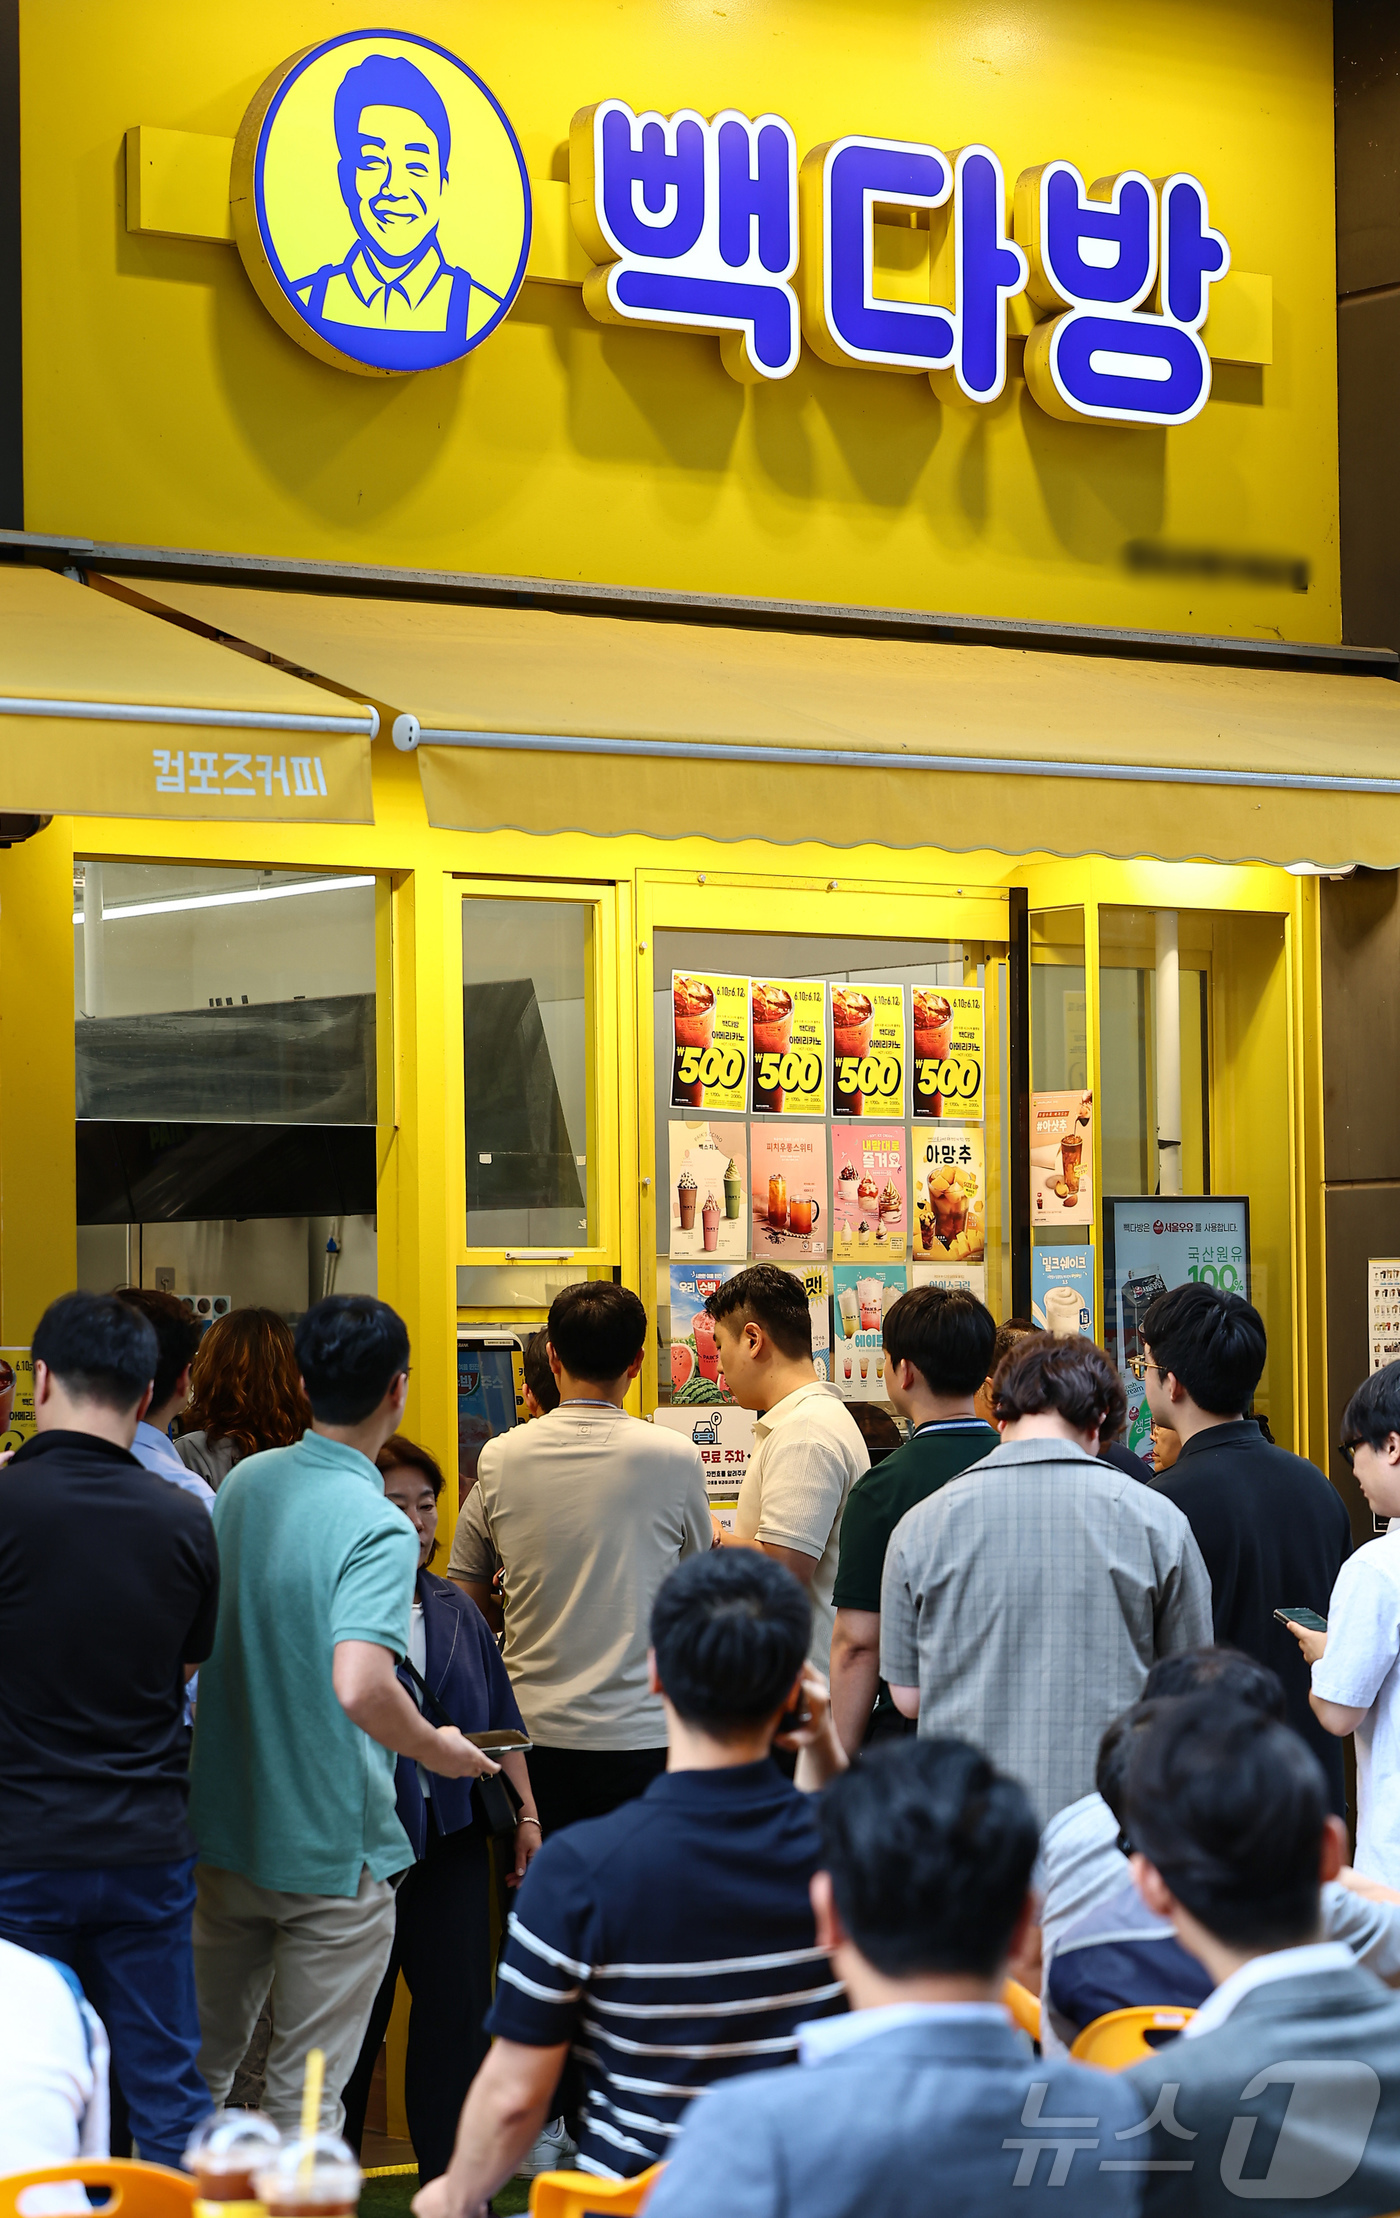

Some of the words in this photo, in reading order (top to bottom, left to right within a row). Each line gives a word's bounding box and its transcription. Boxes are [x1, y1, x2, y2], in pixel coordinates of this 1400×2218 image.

[592, 98, 1230, 427] 빽다방
[152, 749, 328, 797] 컴포즈커피
[711, 1030, 745, 1042] 아메리카노
[789, 1036, 822, 1046] 아메리카노
[868, 1040, 901, 1049] 아메리카노
[948, 1041, 981, 1052] 아메리카노
[766, 1142, 814, 1153] 피치우롱스위티
[862, 1139, 900, 1152] 내맘대로
[863, 1151, 901, 1168] 즐겨요
[926, 1144, 972, 1165] 아.망.추
[1123, 1223, 1150, 1233] 빽다방은
[1164, 1222, 1194, 1233] 서울우유
[1195, 1223, 1202, 1232] 를
[1204, 1222, 1238, 1233] 사용합니다.
[1188, 1246, 1243, 1263] 국산원유
[1042, 1255, 1087, 1272] 밀크쉐이크
[678, 1281, 695, 1293] 우리
[699, 1281, 717, 1293] 수박
[701, 1450, 721, 1464] 무료
[724, 1450, 745, 1463] 주차
